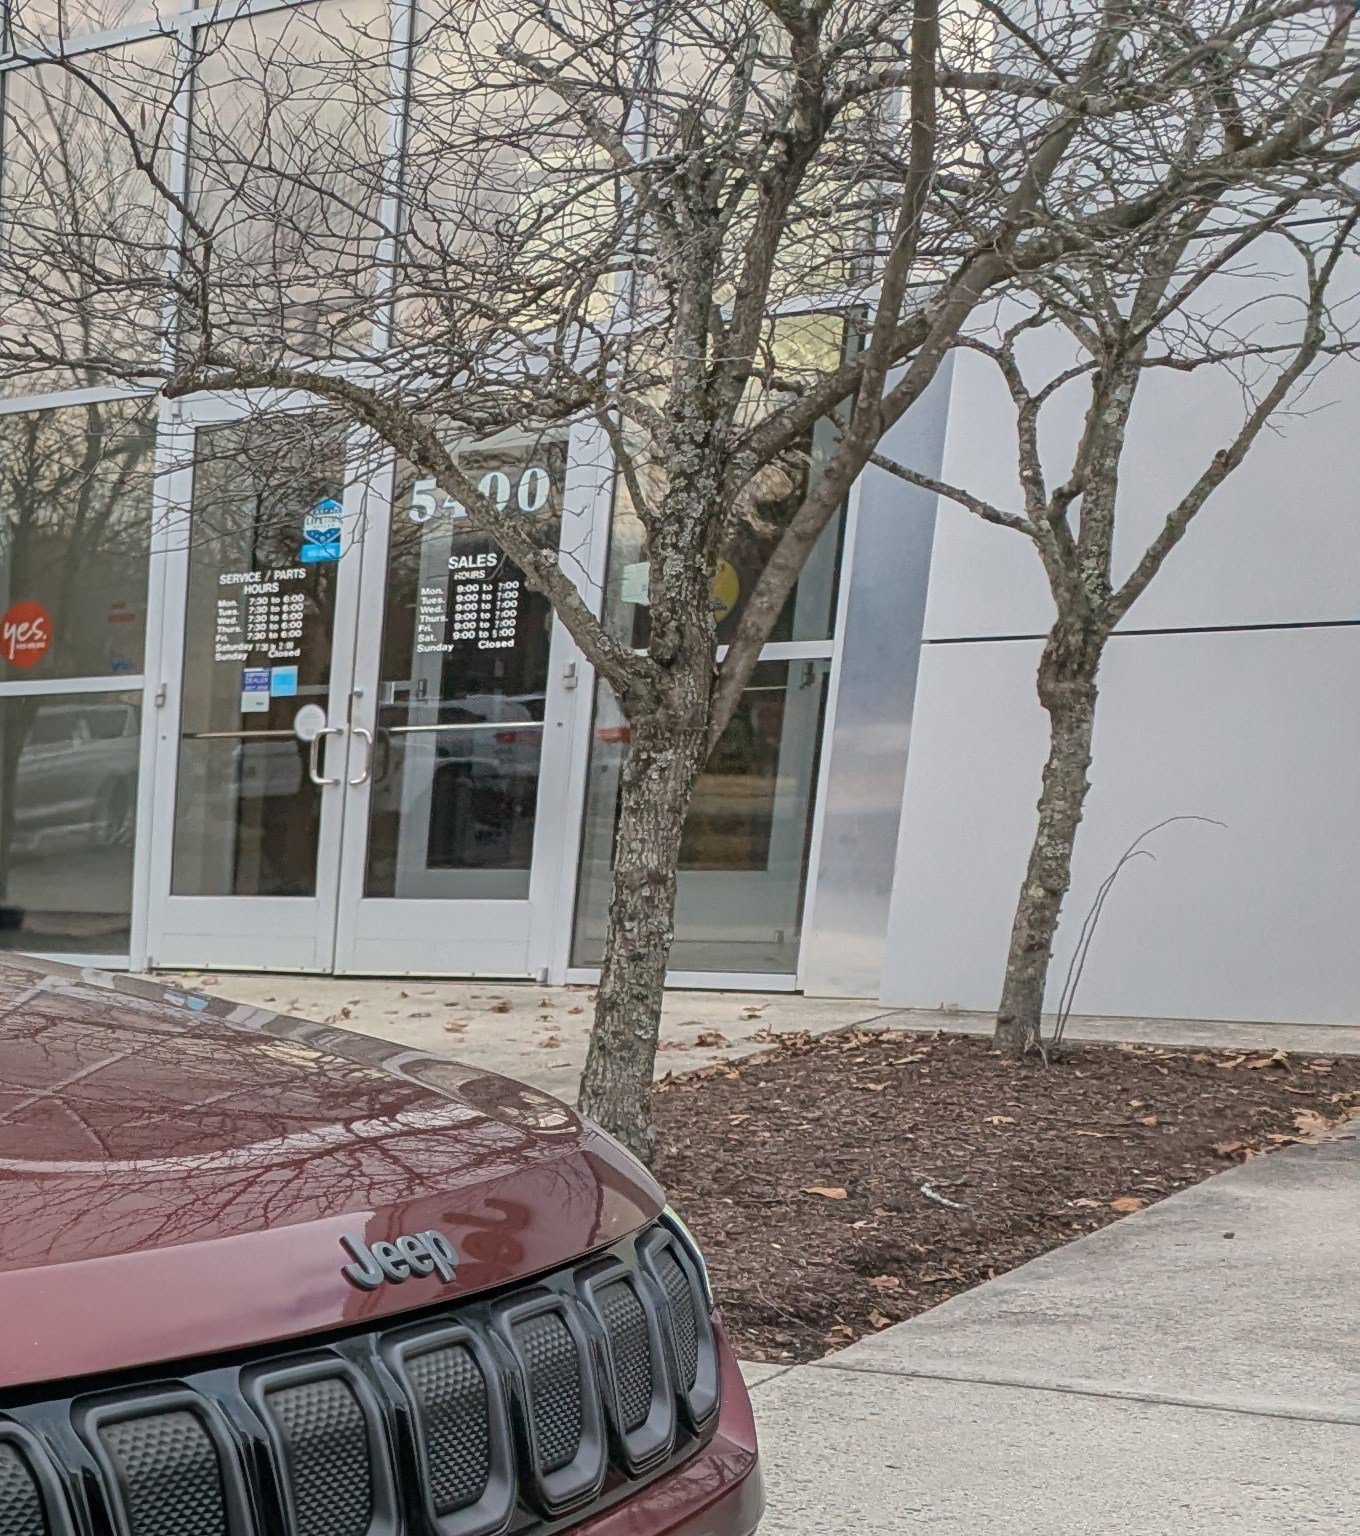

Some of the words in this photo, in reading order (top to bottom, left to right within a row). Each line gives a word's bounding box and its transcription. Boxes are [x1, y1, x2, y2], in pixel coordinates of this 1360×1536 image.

[448, 553, 498, 570] SALES
[219, 572, 262, 585] SERVICE
[273, 568, 307, 581] PARTS
[454, 570, 486, 581] HOURS
[243, 582, 280, 595] HOURS
[420, 588, 444, 596] Mon.
[457, 584, 480, 593] 9:00
[248, 597, 268, 605] 7:30
[270, 596, 280, 604] to
[282, 594, 305, 604] 6:00
[420, 596, 445, 604] Tues.
[456, 594, 479, 602] 9:00
[248, 606, 268, 614] 7:30
[270, 605, 280, 613] to
[282, 603, 304, 612] 6:00
[420, 606, 444, 614] Wed.
[455, 603, 478, 612] 9:00
[481, 602, 491, 610] to
[247, 615, 267, 623] 7:30
[269, 614, 279, 622] to
[281, 612, 303, 621] 6:00
[419, 615, 448, 623] Thurs.
[454, 612, 477, 621] 9:00
[480, 612, 491, 620] to
[247, 624, 267, 632] 7:30
[269, 622, 279, 630] to
[280, 621, 303, 630] 6:00
[418, 624, 433, 632] Fri.
[454, 622, 476, 630] 9:00
[3, 617, 47, 661] yes.
[246, 632, 266, 640] 7:30
[268, 632, 278, 640] to
[280, 630, 302, 638] 6:00
[418, 634, 436, 642] Sat.
[452, 631, 476, 640] 9:00
[479, 630, 489, 638] to
[215, 643, 253, 653] Saturday
[417, 643, 454, 653] Sunday
[478, 639, 515, 649] Closed
[215, 652, 248, 662] Sunday
[268, 648, 301, 659] Closed
[339, 1229, 460, 1290] Jeep
